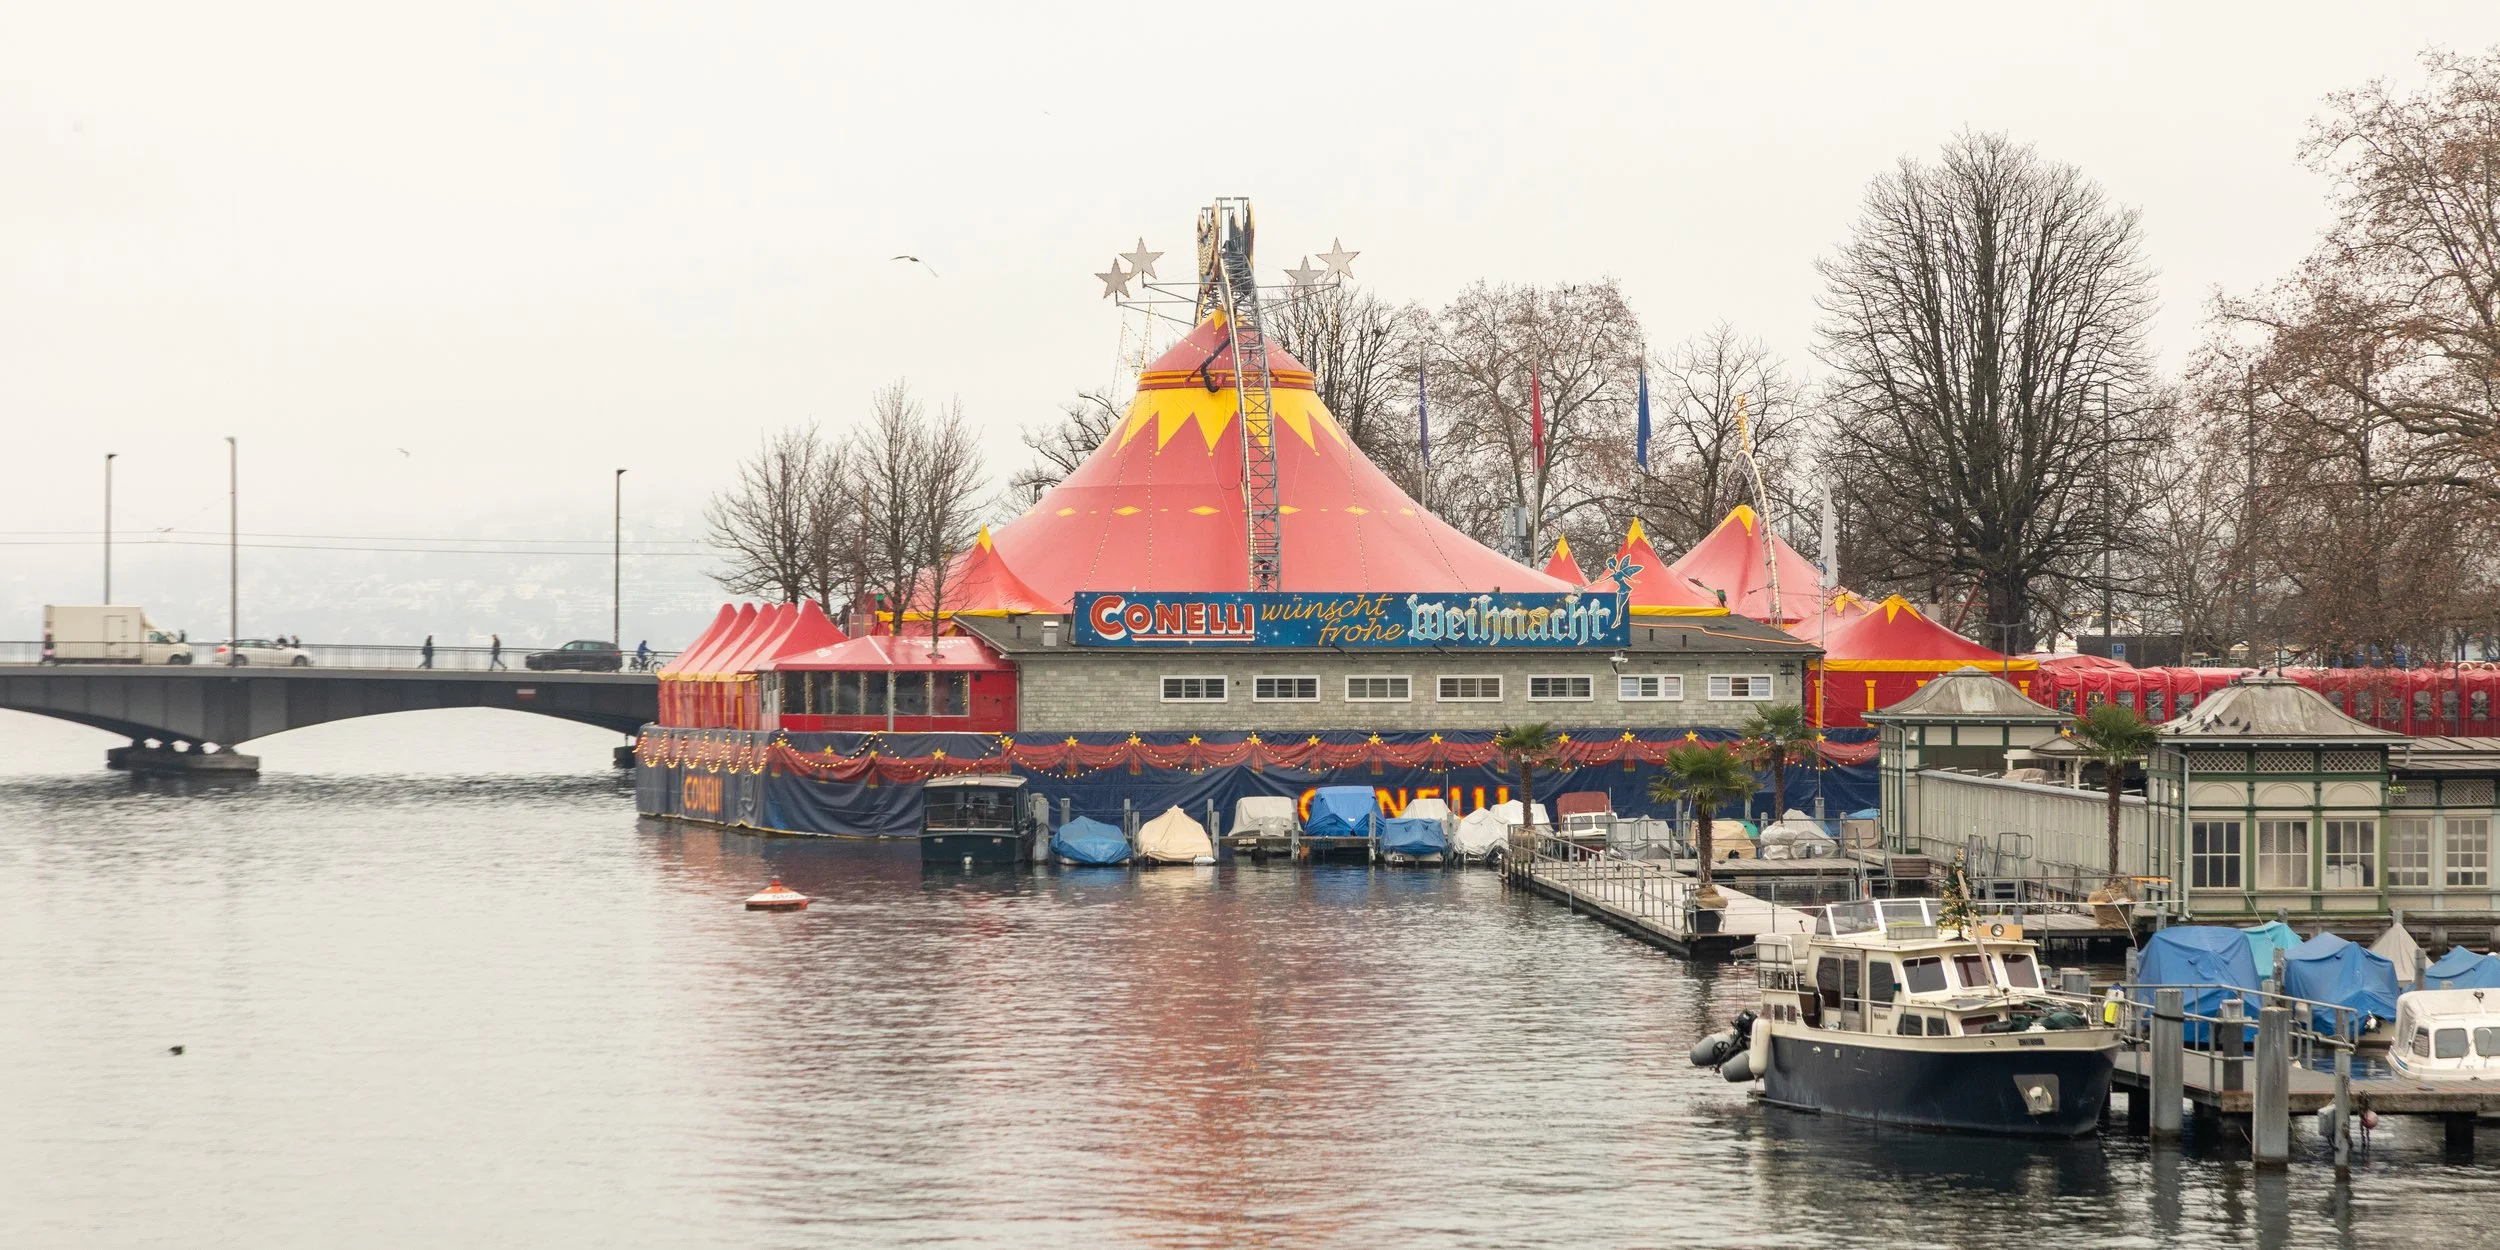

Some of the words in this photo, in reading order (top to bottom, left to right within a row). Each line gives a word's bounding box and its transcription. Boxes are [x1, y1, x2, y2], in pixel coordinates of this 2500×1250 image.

[1090, 594, 1255, 641] CONELLI
[1261, 594, 1394, 621] wünscht
[1406, 594, 1611, 646] Weihnacht
[1318, 617, 1406, 646] frohe
